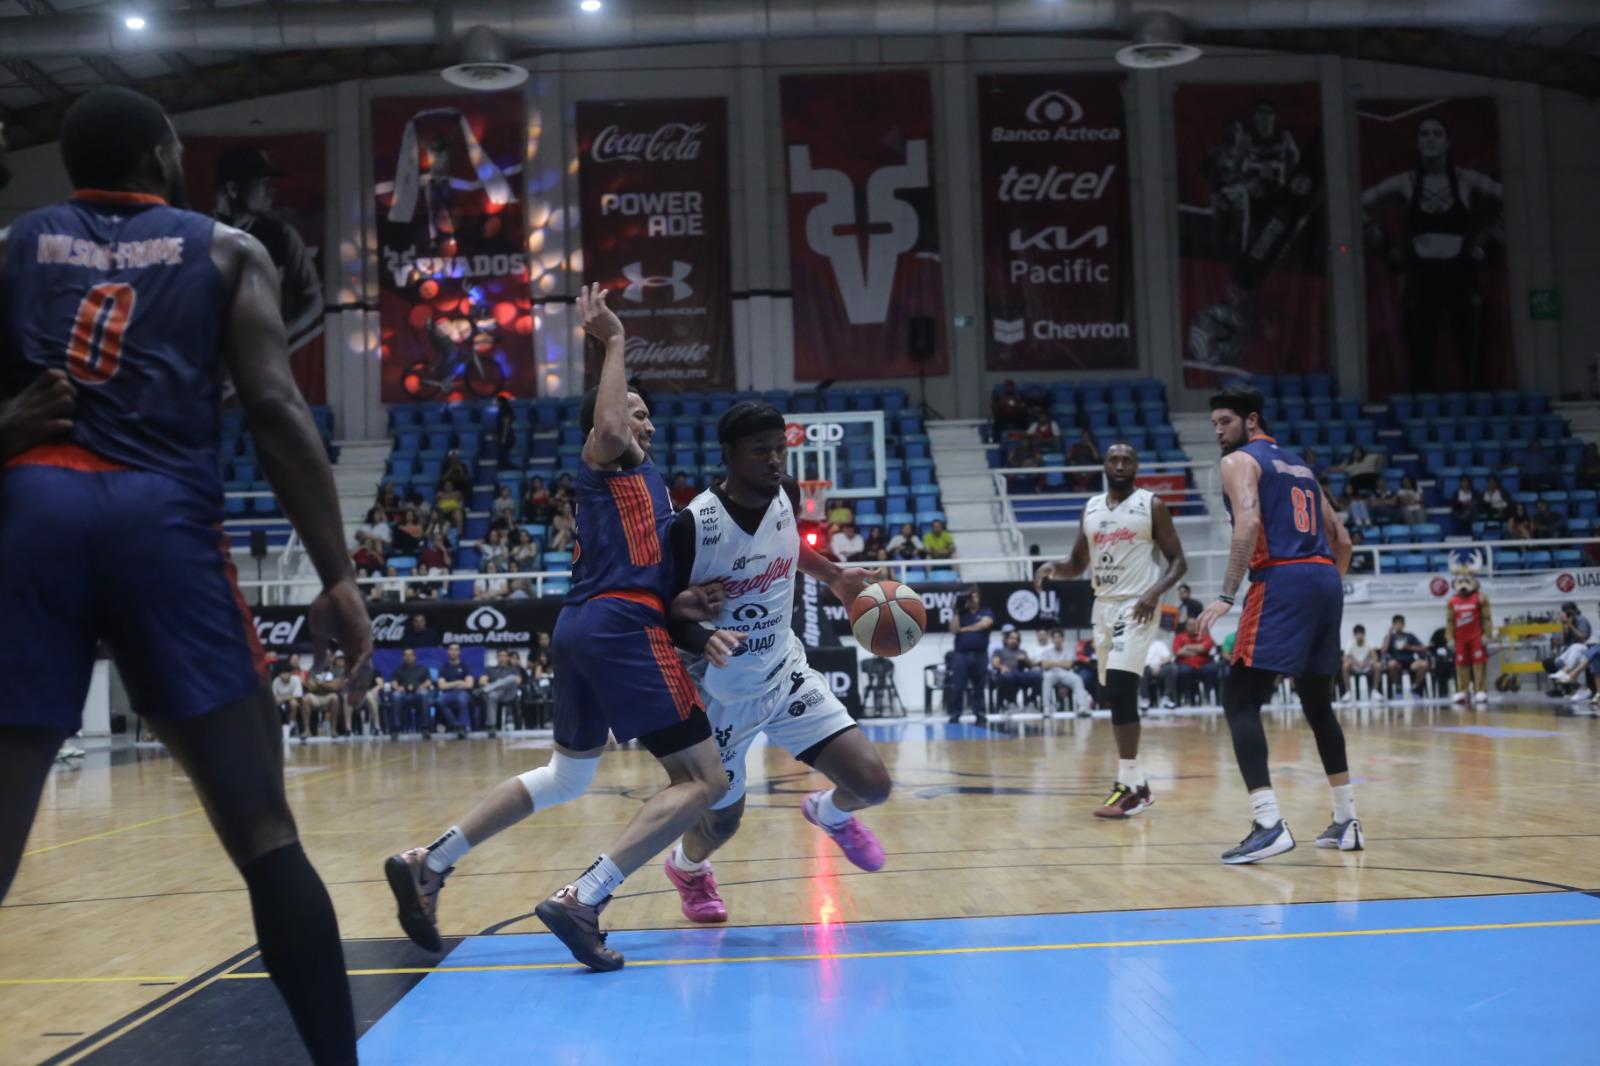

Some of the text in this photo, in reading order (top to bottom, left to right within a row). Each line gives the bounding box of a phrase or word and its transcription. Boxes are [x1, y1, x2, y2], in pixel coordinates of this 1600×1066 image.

[992, 125, 1120, 142] Banco Azteca
[998, 164, 1115, 202] telcel
[601, 191, 703, 217] POWER
[648, 215, 704, 238] ADE
[1010, 258, 1109, 284] Pacific
[66, 282, 137, 384] 0
[1033, 320, 1129, 340] Chevron
[1290, 486, 1317, 536] 81
[443, 630, 530, 644] Banco Azteca
[748, 633, 776, 652] UAD
